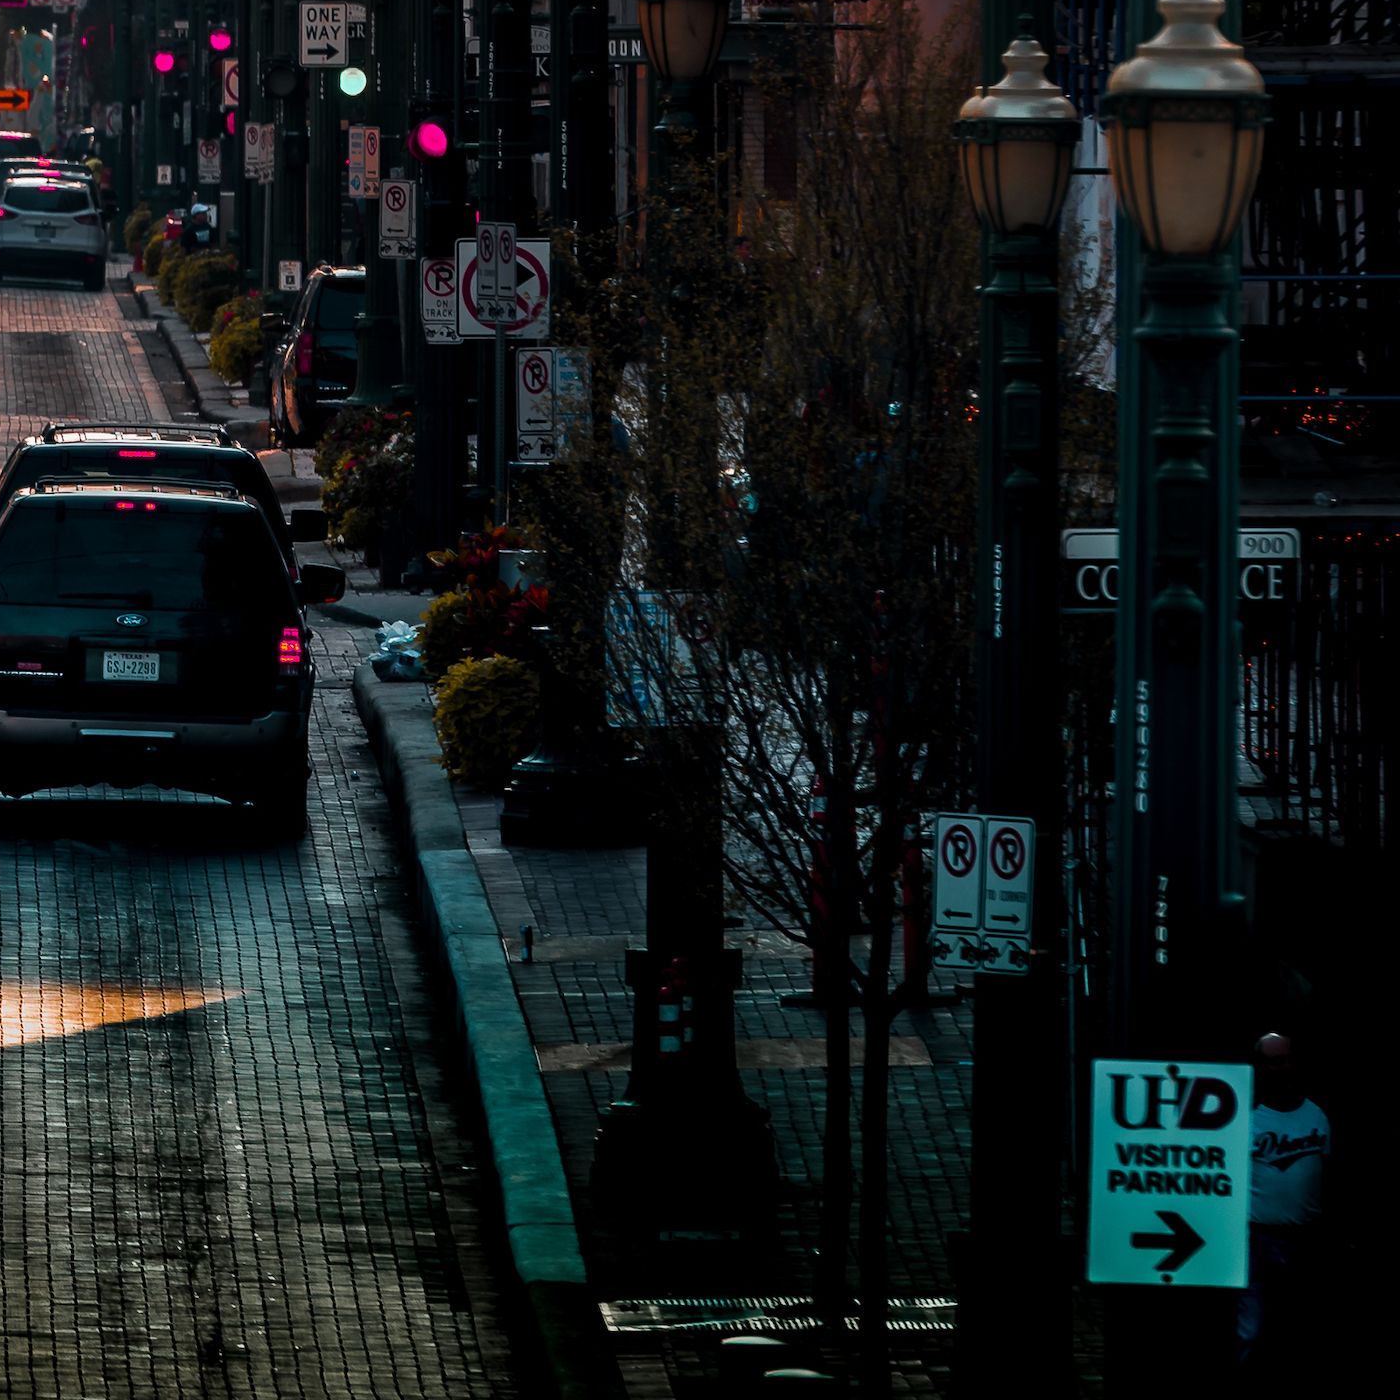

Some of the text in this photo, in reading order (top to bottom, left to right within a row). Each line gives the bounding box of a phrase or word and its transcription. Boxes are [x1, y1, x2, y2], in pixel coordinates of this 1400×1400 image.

[307, 7, 341, 23] ONE
[306, 25, 342, 41] WAY
[608, 39, 642, 57] OON
[436, 299, 449, 308] ON
[425, 309, 455, 318] TRACK
[1244, 536, 1286, 554] 900
[1075, 564, 1284, 601] COCE
[123, 614, 142, 625] Ford
[1106, 1073, 1240, 1130] UHD
[1114, 1143, 1227, 1170] VISITOR
[1106, 1168, 1233, 1197] PARKING
